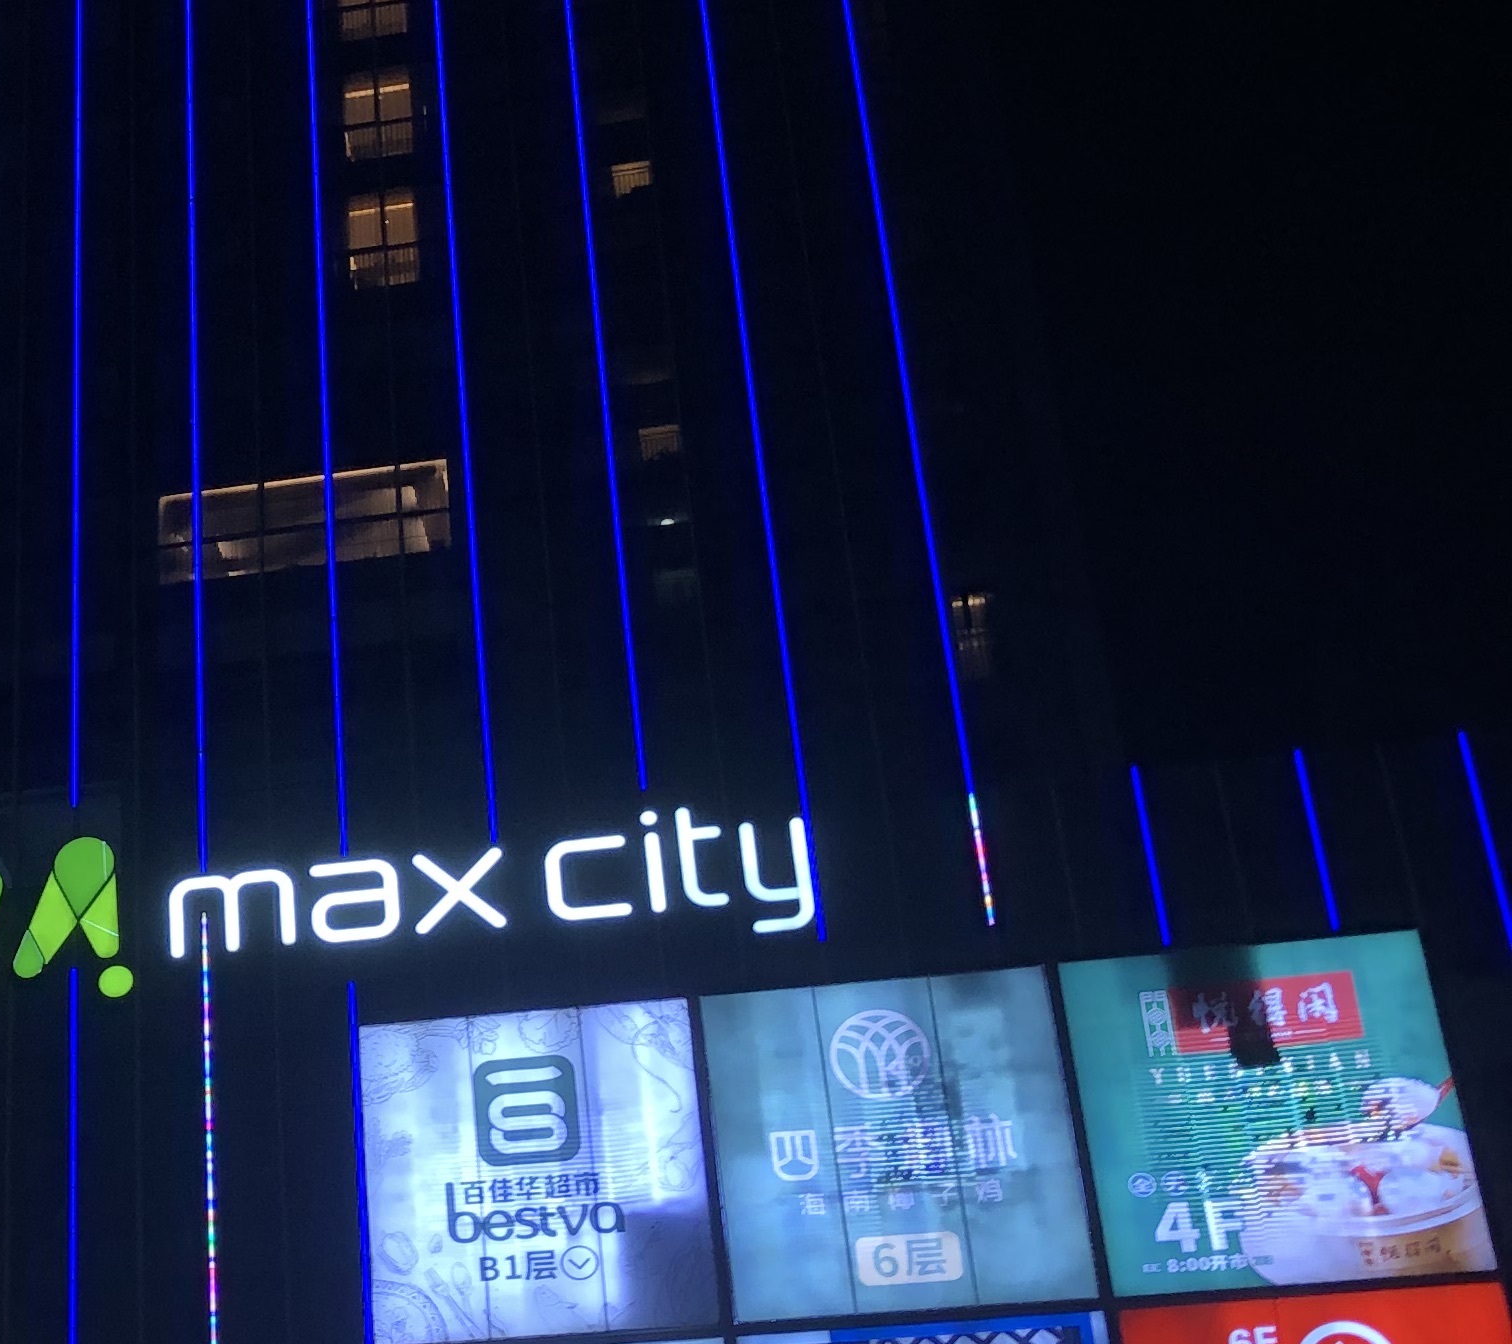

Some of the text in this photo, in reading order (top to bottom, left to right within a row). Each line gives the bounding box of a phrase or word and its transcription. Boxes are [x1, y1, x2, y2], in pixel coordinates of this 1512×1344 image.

[168, 807, 816, 959] max city
[769, 1113, 1017, 1182] 四季林
[445, 1182, 626, 1244] bestva
[460, 1172, 600, 1205] 百佳华超市
[1154, 1201, 1245, 1253] 4F
[479, 1249, 557, 1282] B1层
[872, 1238, 947, 1278] 6层
